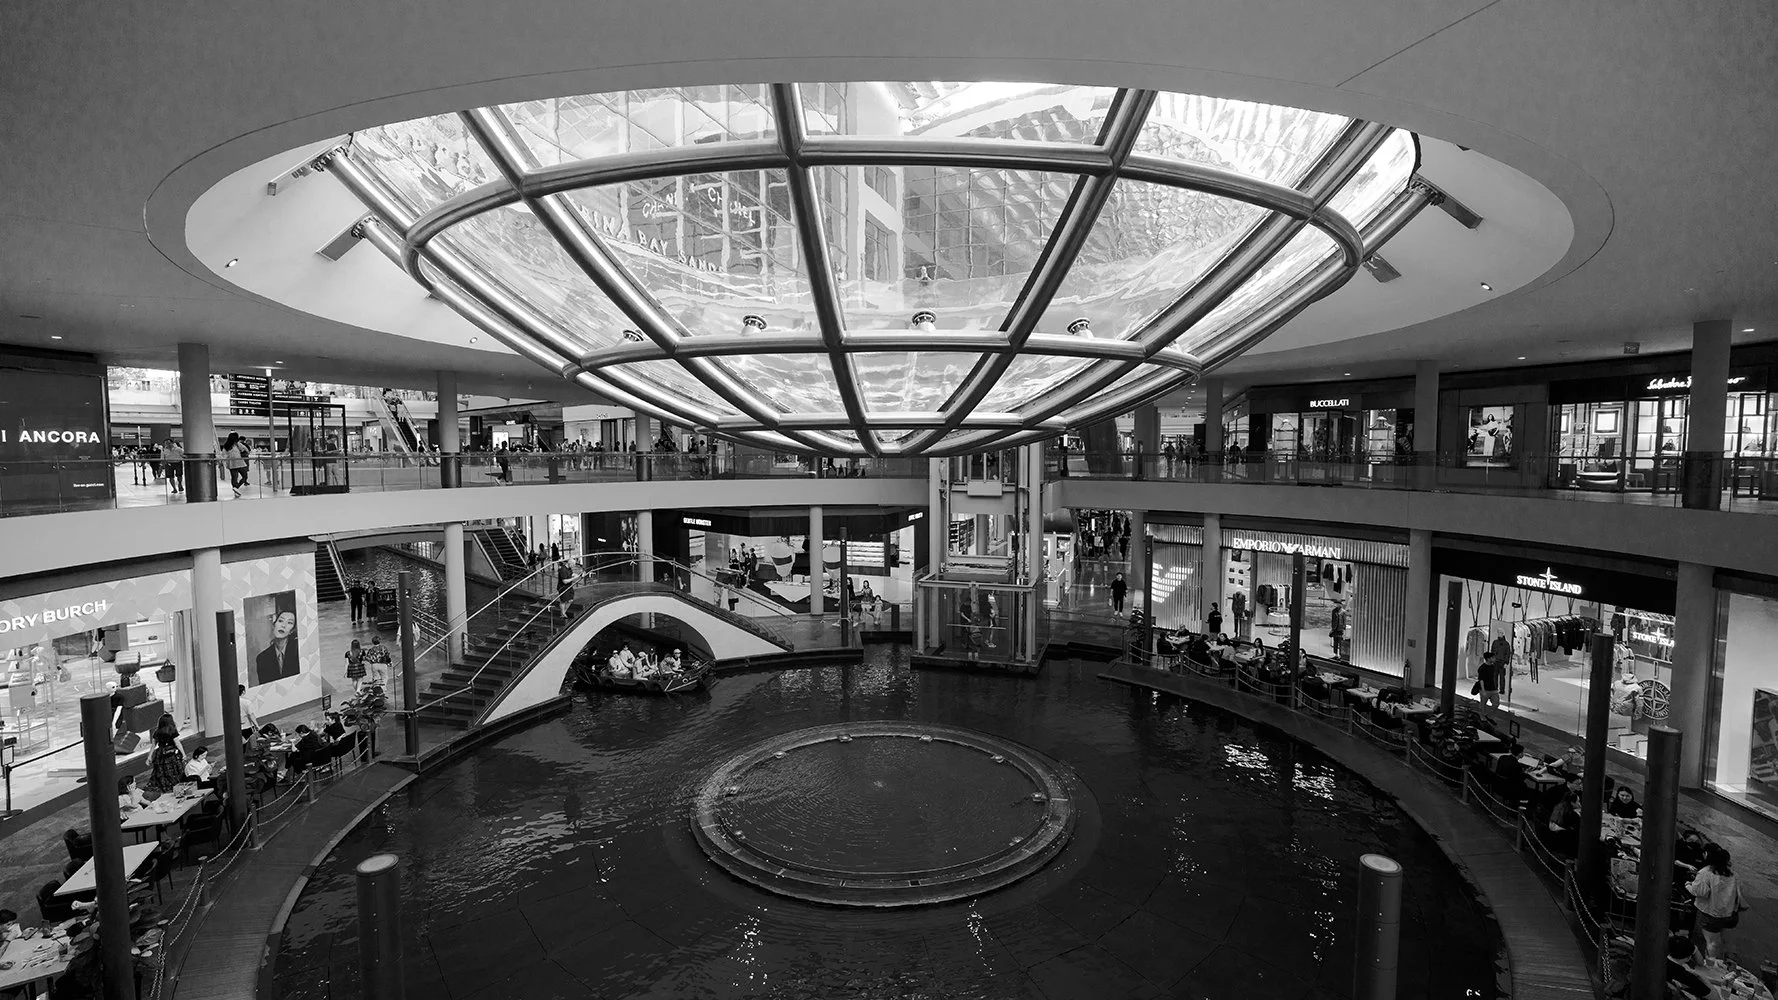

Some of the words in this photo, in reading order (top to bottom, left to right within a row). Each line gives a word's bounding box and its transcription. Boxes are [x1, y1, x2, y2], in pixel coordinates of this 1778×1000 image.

[637, 228, 668, 256] BAY
[1310, 399, 1349, 407] BUCCELLATI
[19, 430, 100, 443] ANCORA
[1233, 538, 1281, 552] EMPORIO
[1298, 544, 1341, 559] ARMANI
[1517, 575, 1546, 588] STONE
[1549, 581, 1582, 594] ISLAND
[0, 613, 39, 634] ORY
[43, 600, 106, 623] BURCH
[1633, 632, 1657, 643] STONE
[1659, 637, 1675, 647] ISLA
